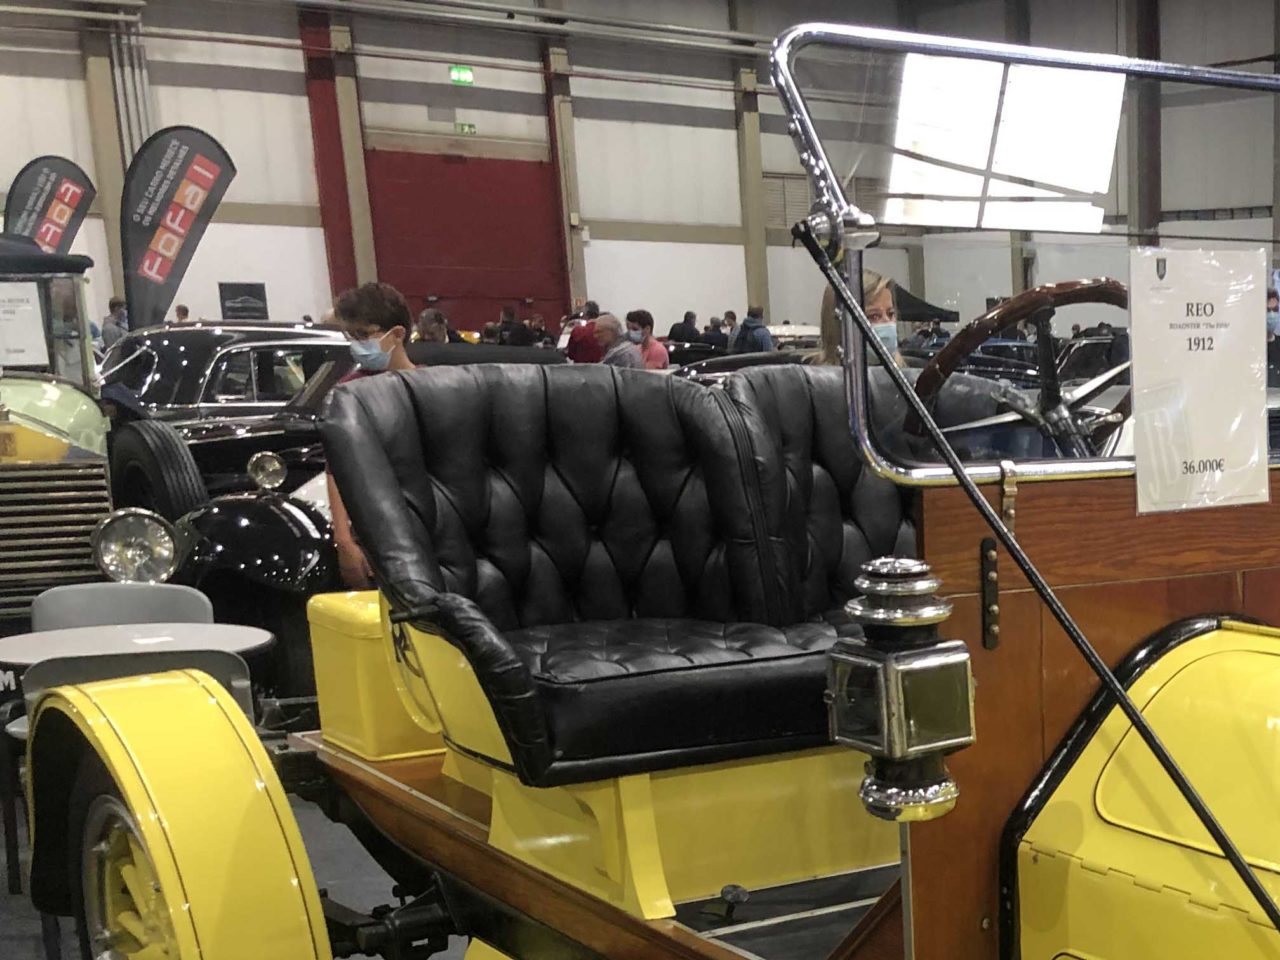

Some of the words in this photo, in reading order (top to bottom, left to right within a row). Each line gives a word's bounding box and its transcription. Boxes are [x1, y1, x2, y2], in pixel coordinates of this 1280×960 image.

[1185, 302, 1215, 317] REO
[1186, 337, 1214, 351] 1912
[1182, 458, 1225, 475] 36.000€
